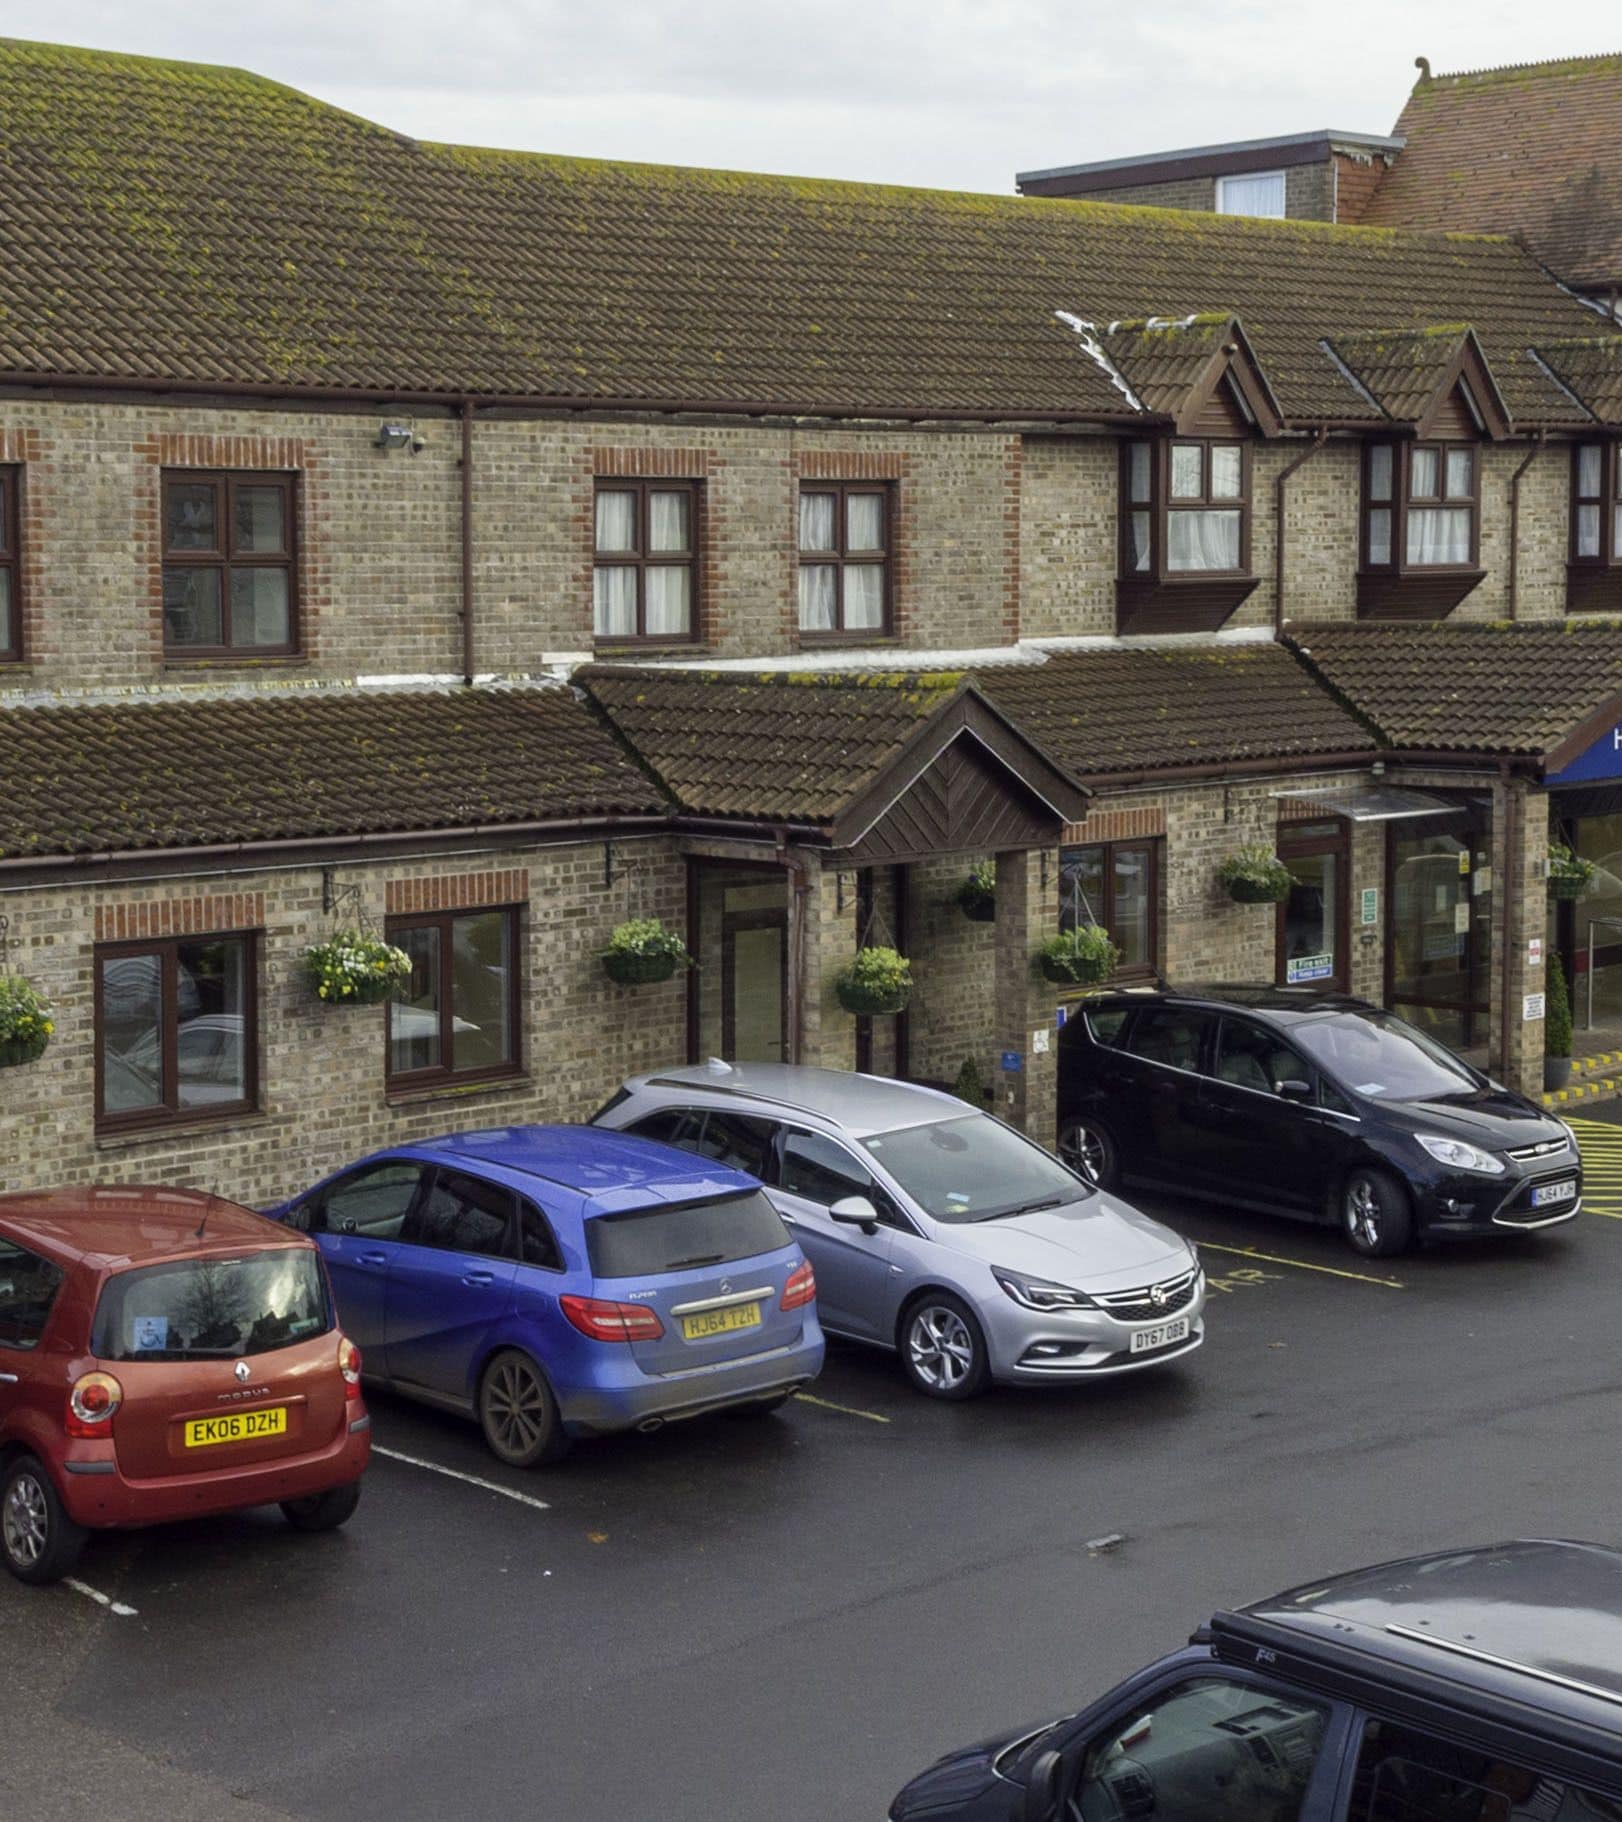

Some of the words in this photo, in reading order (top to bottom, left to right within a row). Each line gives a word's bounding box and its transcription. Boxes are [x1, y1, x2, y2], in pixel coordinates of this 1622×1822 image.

[690, 1313, 726, 1335] HJ64
[1136, 1327, 1165, 1348] DY67
[193, 1418, 241, 1441] EK06
[246, 1411, 279, 1433] DZH
